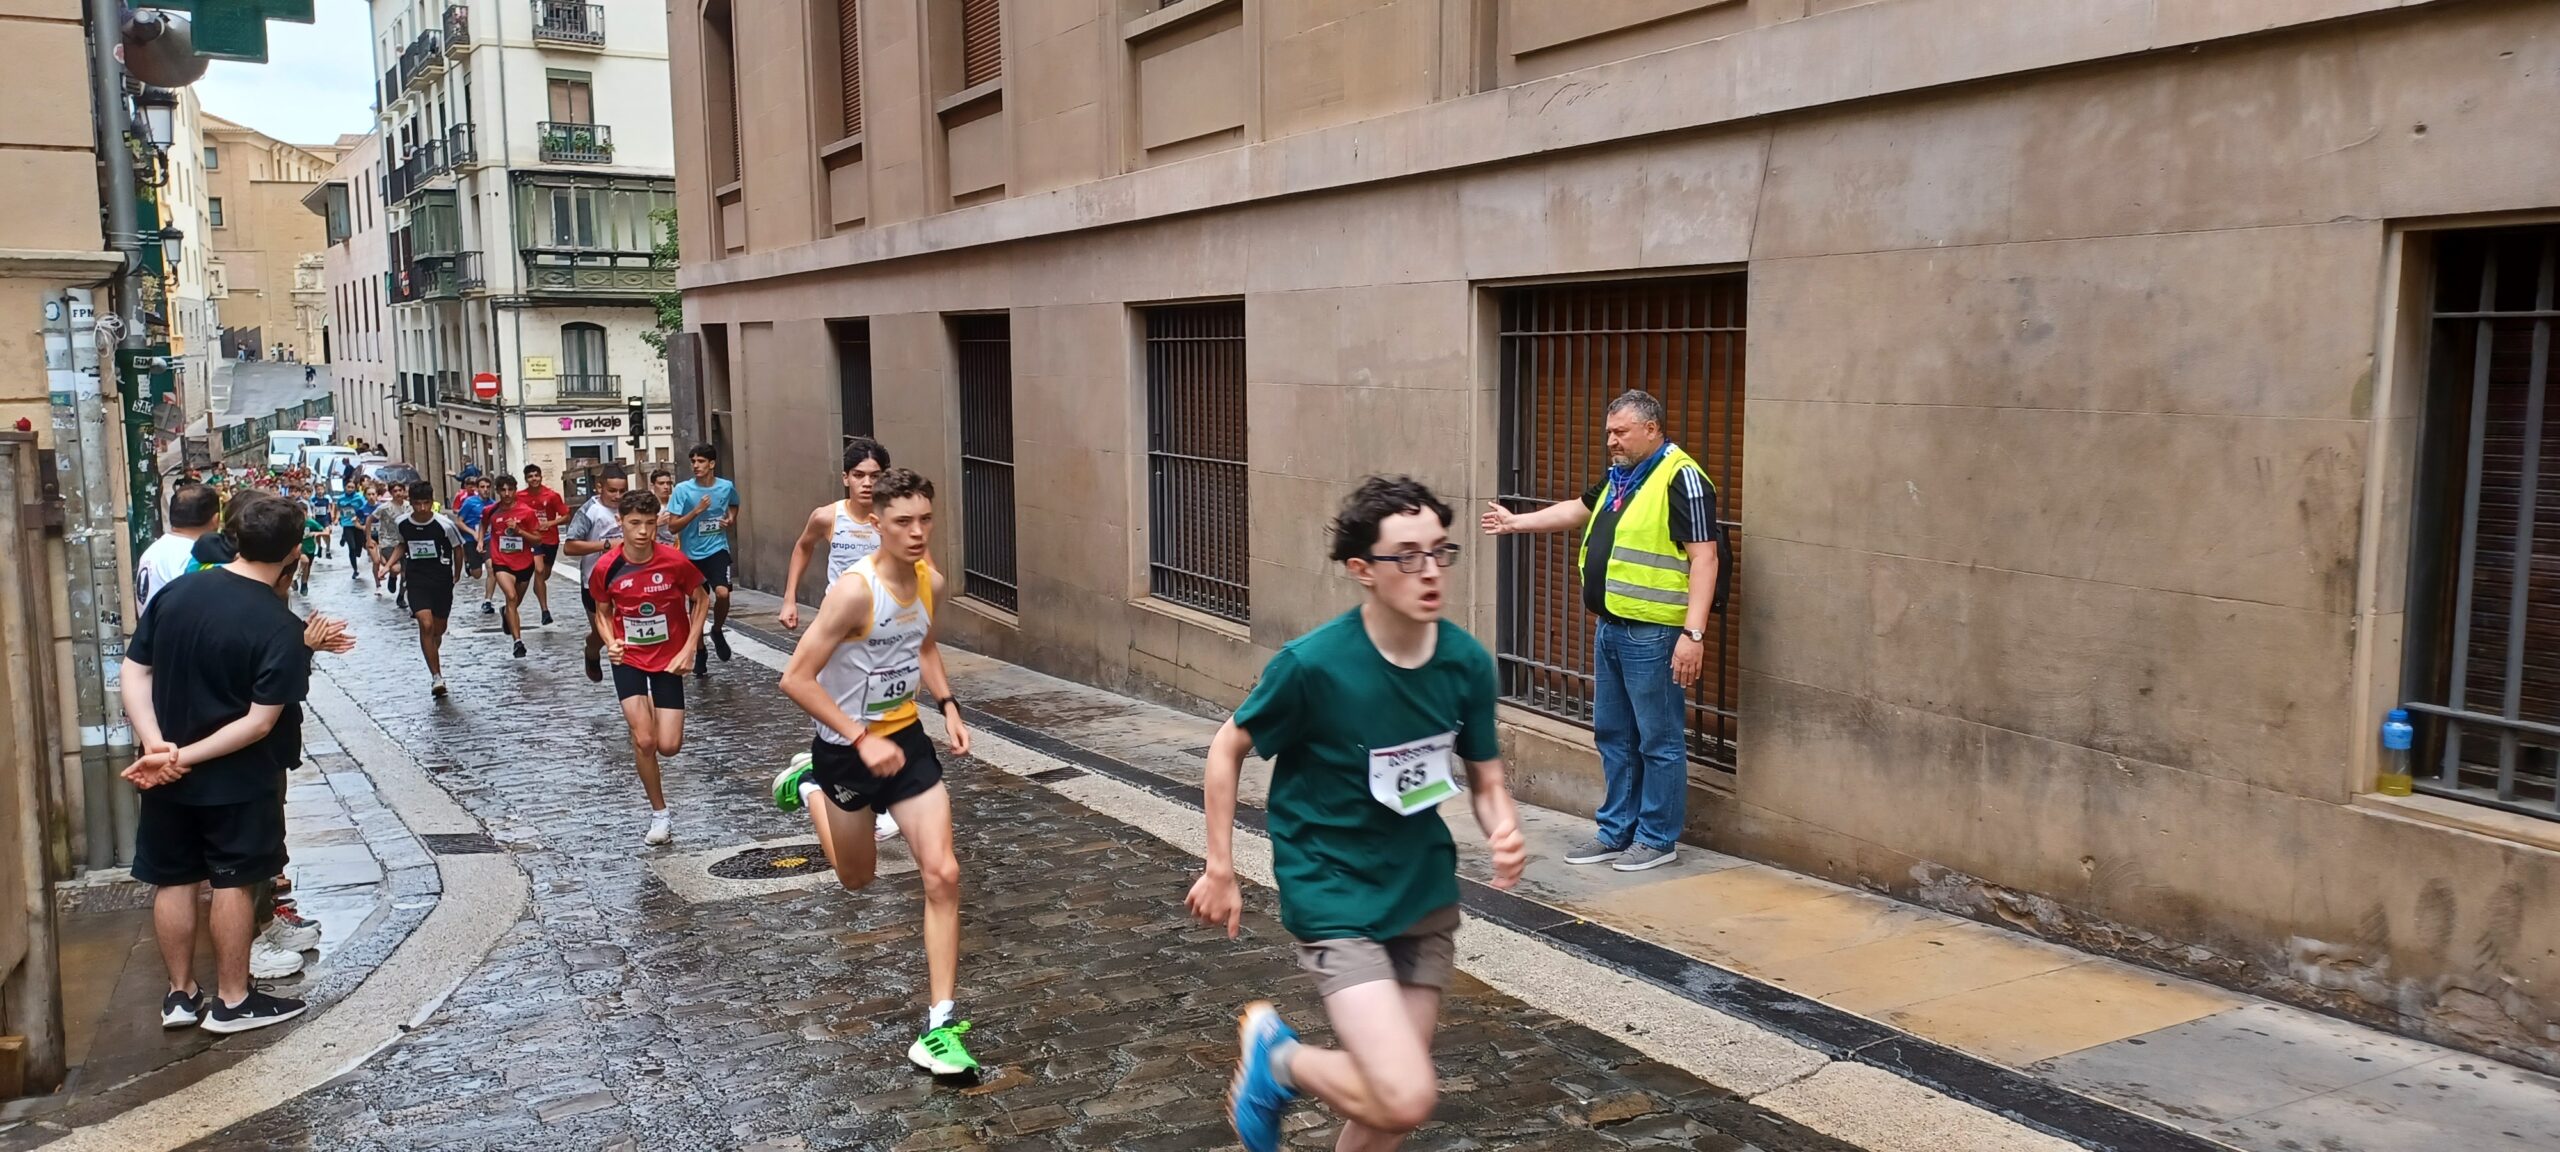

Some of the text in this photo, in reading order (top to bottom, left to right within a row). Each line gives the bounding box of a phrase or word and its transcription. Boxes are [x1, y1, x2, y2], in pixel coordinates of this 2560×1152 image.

[574, 416, 621, 430] markaje
[636, 627, 656, 638] 14
[883, 680, 907, 698] 49
[1397, 761, 1427, 793] 65
